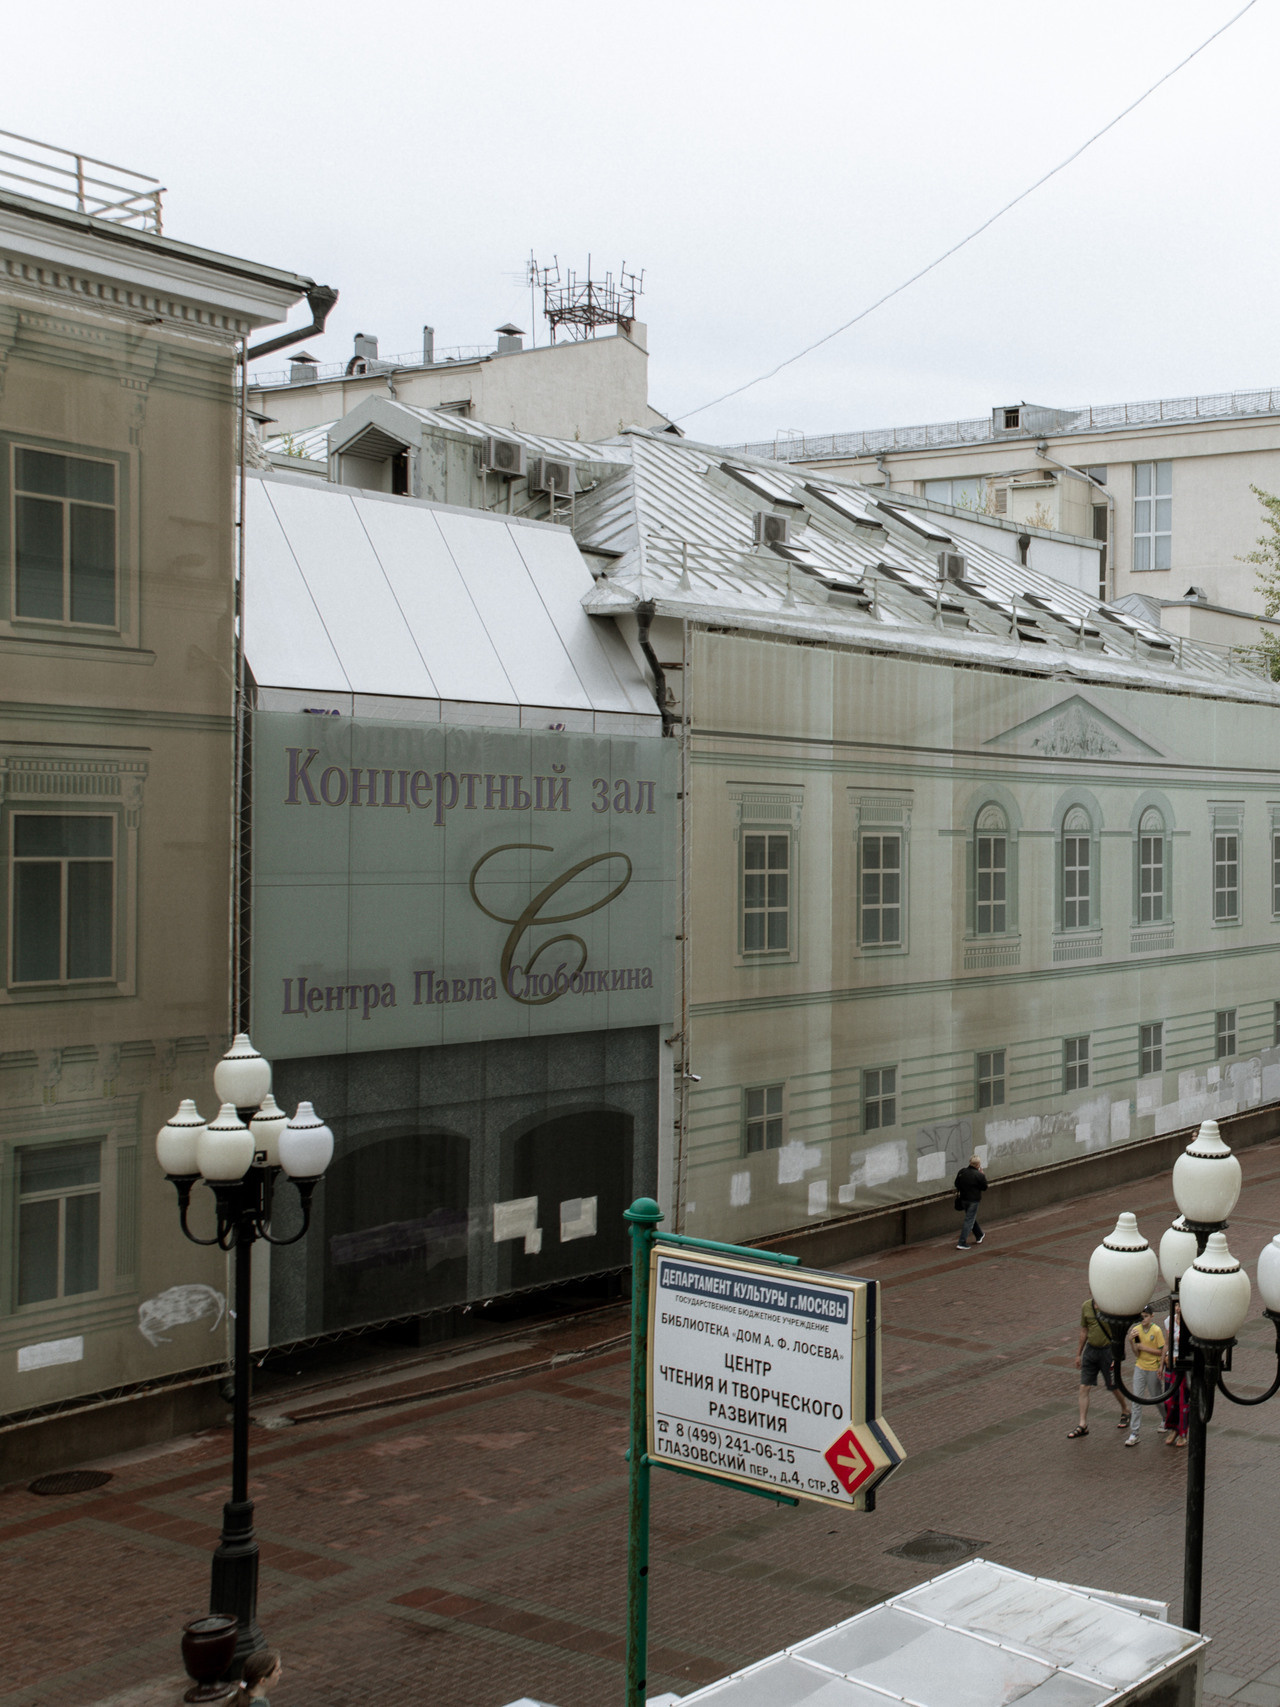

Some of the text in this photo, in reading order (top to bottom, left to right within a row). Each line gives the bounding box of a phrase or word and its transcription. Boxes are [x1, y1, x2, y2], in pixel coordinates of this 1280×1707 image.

[284, 747, 656, 826] Концертный зал
[281, 962, 653, 1020] Центра Павла Слободкина
[662, 1268, 731, 1296] ДЕПАРТАМЕНТ
[734, 1282, 787, 1308] КУЛЬТУРЫ
[675, 1295, 829, 1332] ГОСУДАРСТВЕННОЕ БЮДЖЕТНОЕ УЧРЕЖДЕНИЕ
[661, 1313, 844, 1361] БИБЛИОТЕКА «ДОМ А. Ф. ЛОСЕВА»
[725, 1353, 771, 1376] ЦЕНТР
[659, 1365, 843, 1420] ЧТЕНИЯ И ТВОРЧЕСКОГО
[709, 1402, 787, 1433] РАЗВИТИЯ
[658, 1438, 746, 1472] ГЛАЗОВСКИЙ
[676, 1423, 795, 1464] 8 (499) 241-06-15
